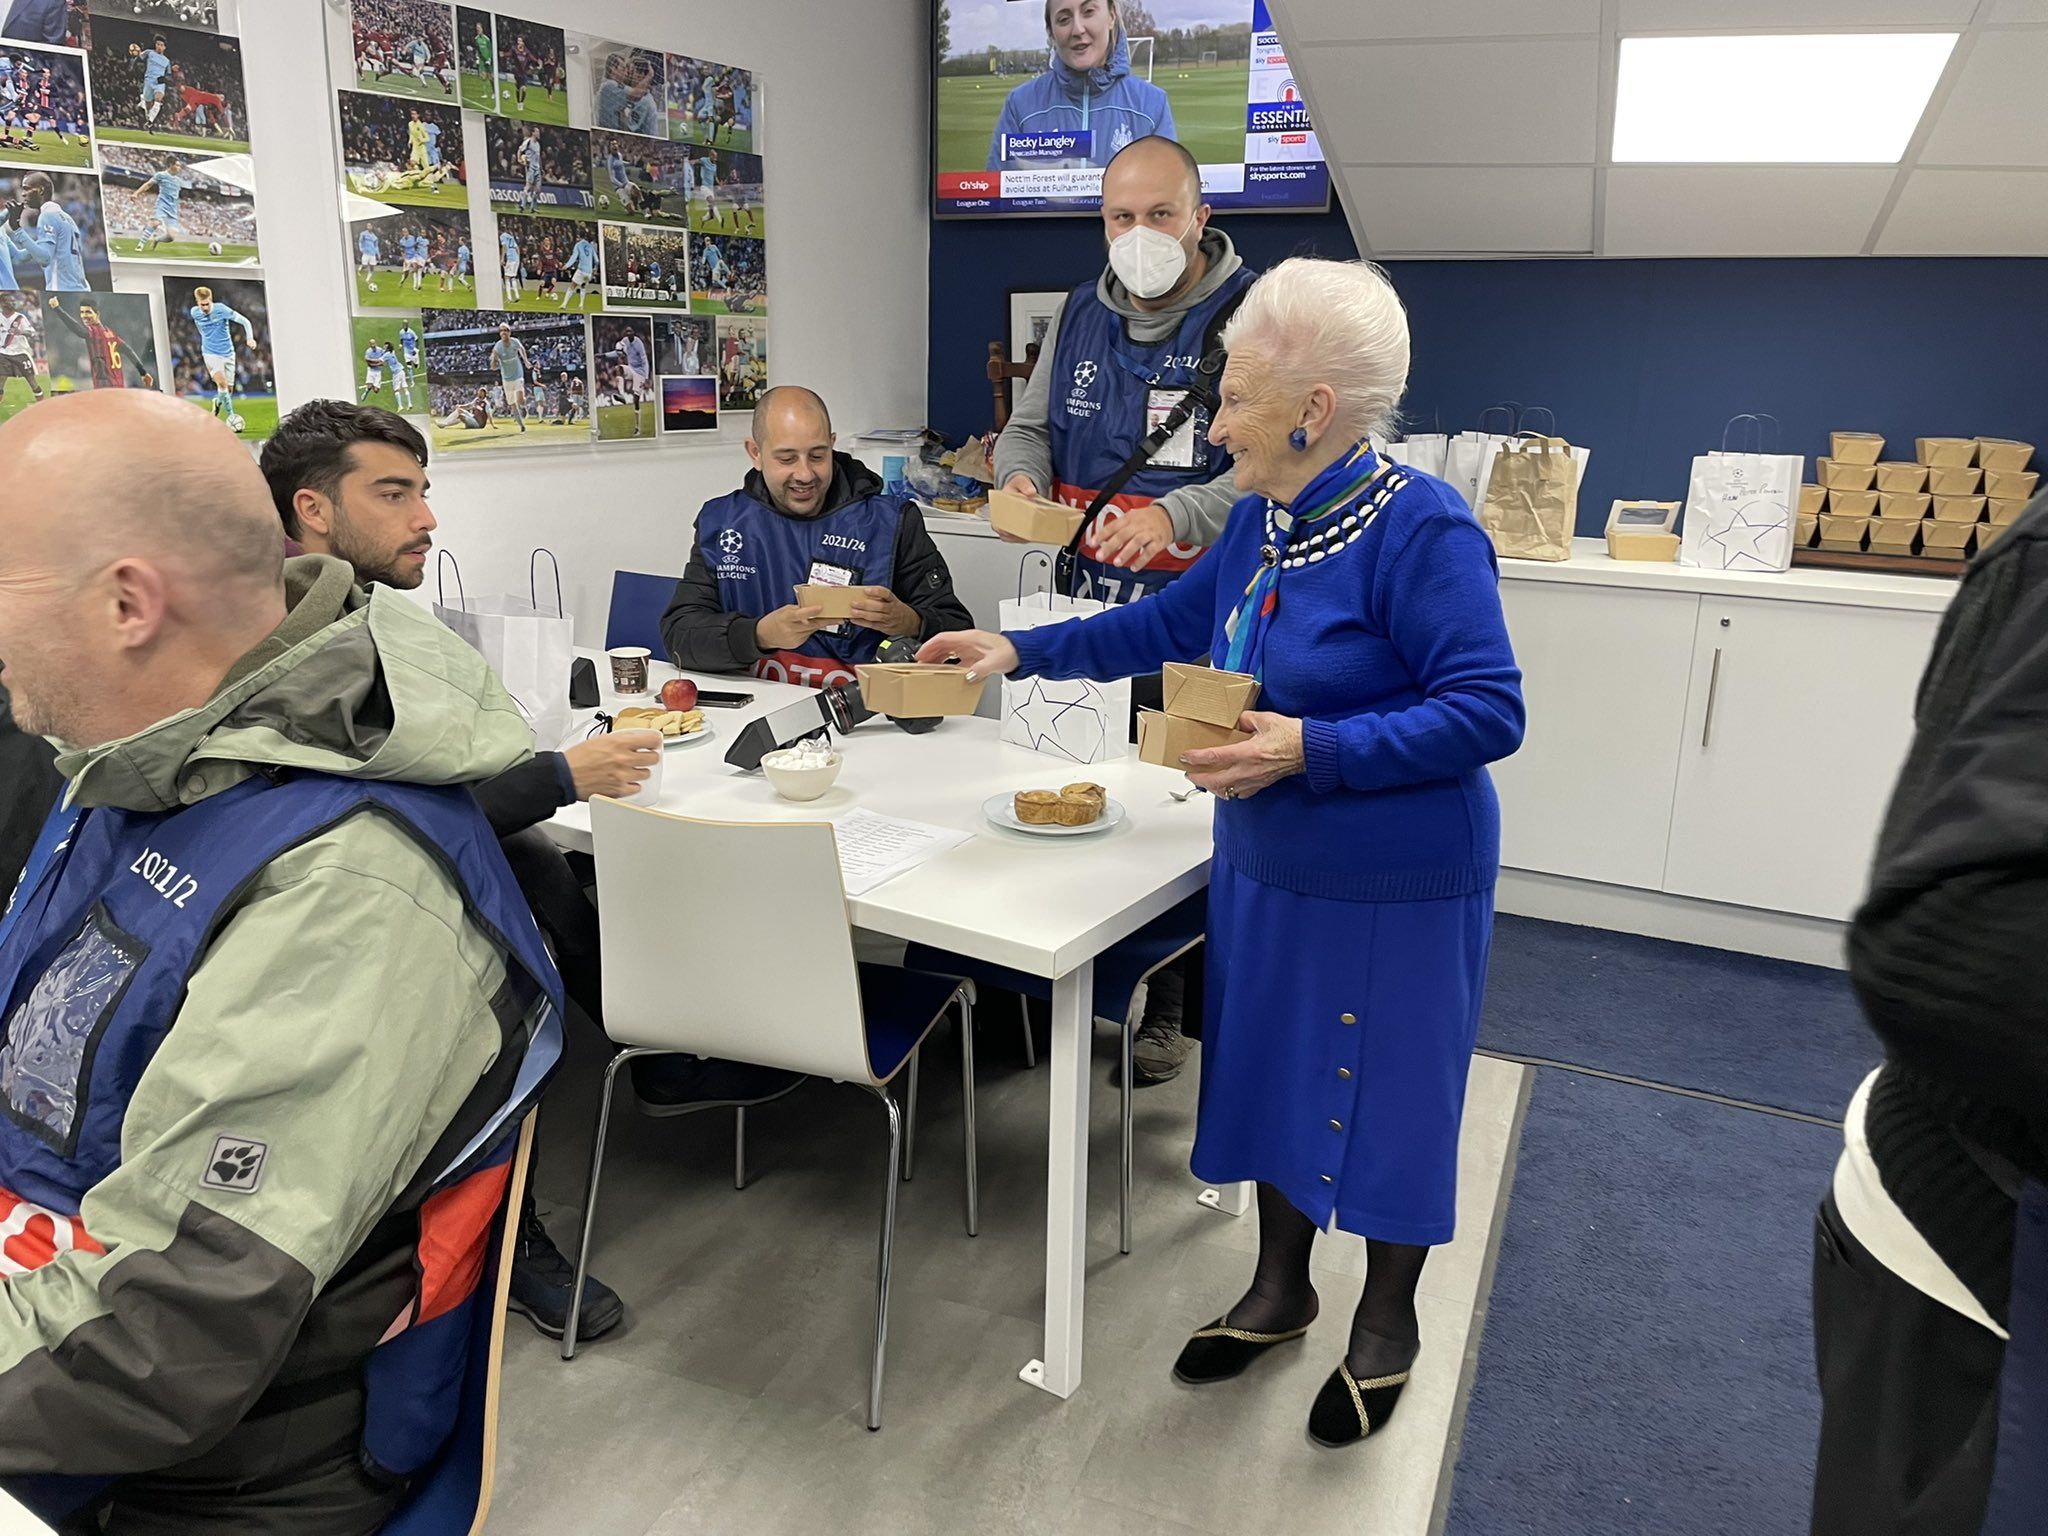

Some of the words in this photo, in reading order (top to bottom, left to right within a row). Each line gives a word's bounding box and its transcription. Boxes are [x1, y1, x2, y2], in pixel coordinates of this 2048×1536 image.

[1009, 136, 1038, 149] Becky
[1039, 134, 1076, 148] Langley
[1281, 134, 1306, 143] sports
[1005, 174, 1031, 183] Nott'm
[1033, 173, 1056, 182] Forest
[1057, 173, 1070, 181] will
[1249, 171, 1306, 181] skysports.com
[959, 180, 990, 192] Ch'ship
[1005, 184, 1025, 194] avoid
[1026, 184, 1041, 192] loss
[1052, 183, 1079, 192] Fulham
[1080, 183, 1100, 191] while
[821, 533, 867, 553] 2021/24
